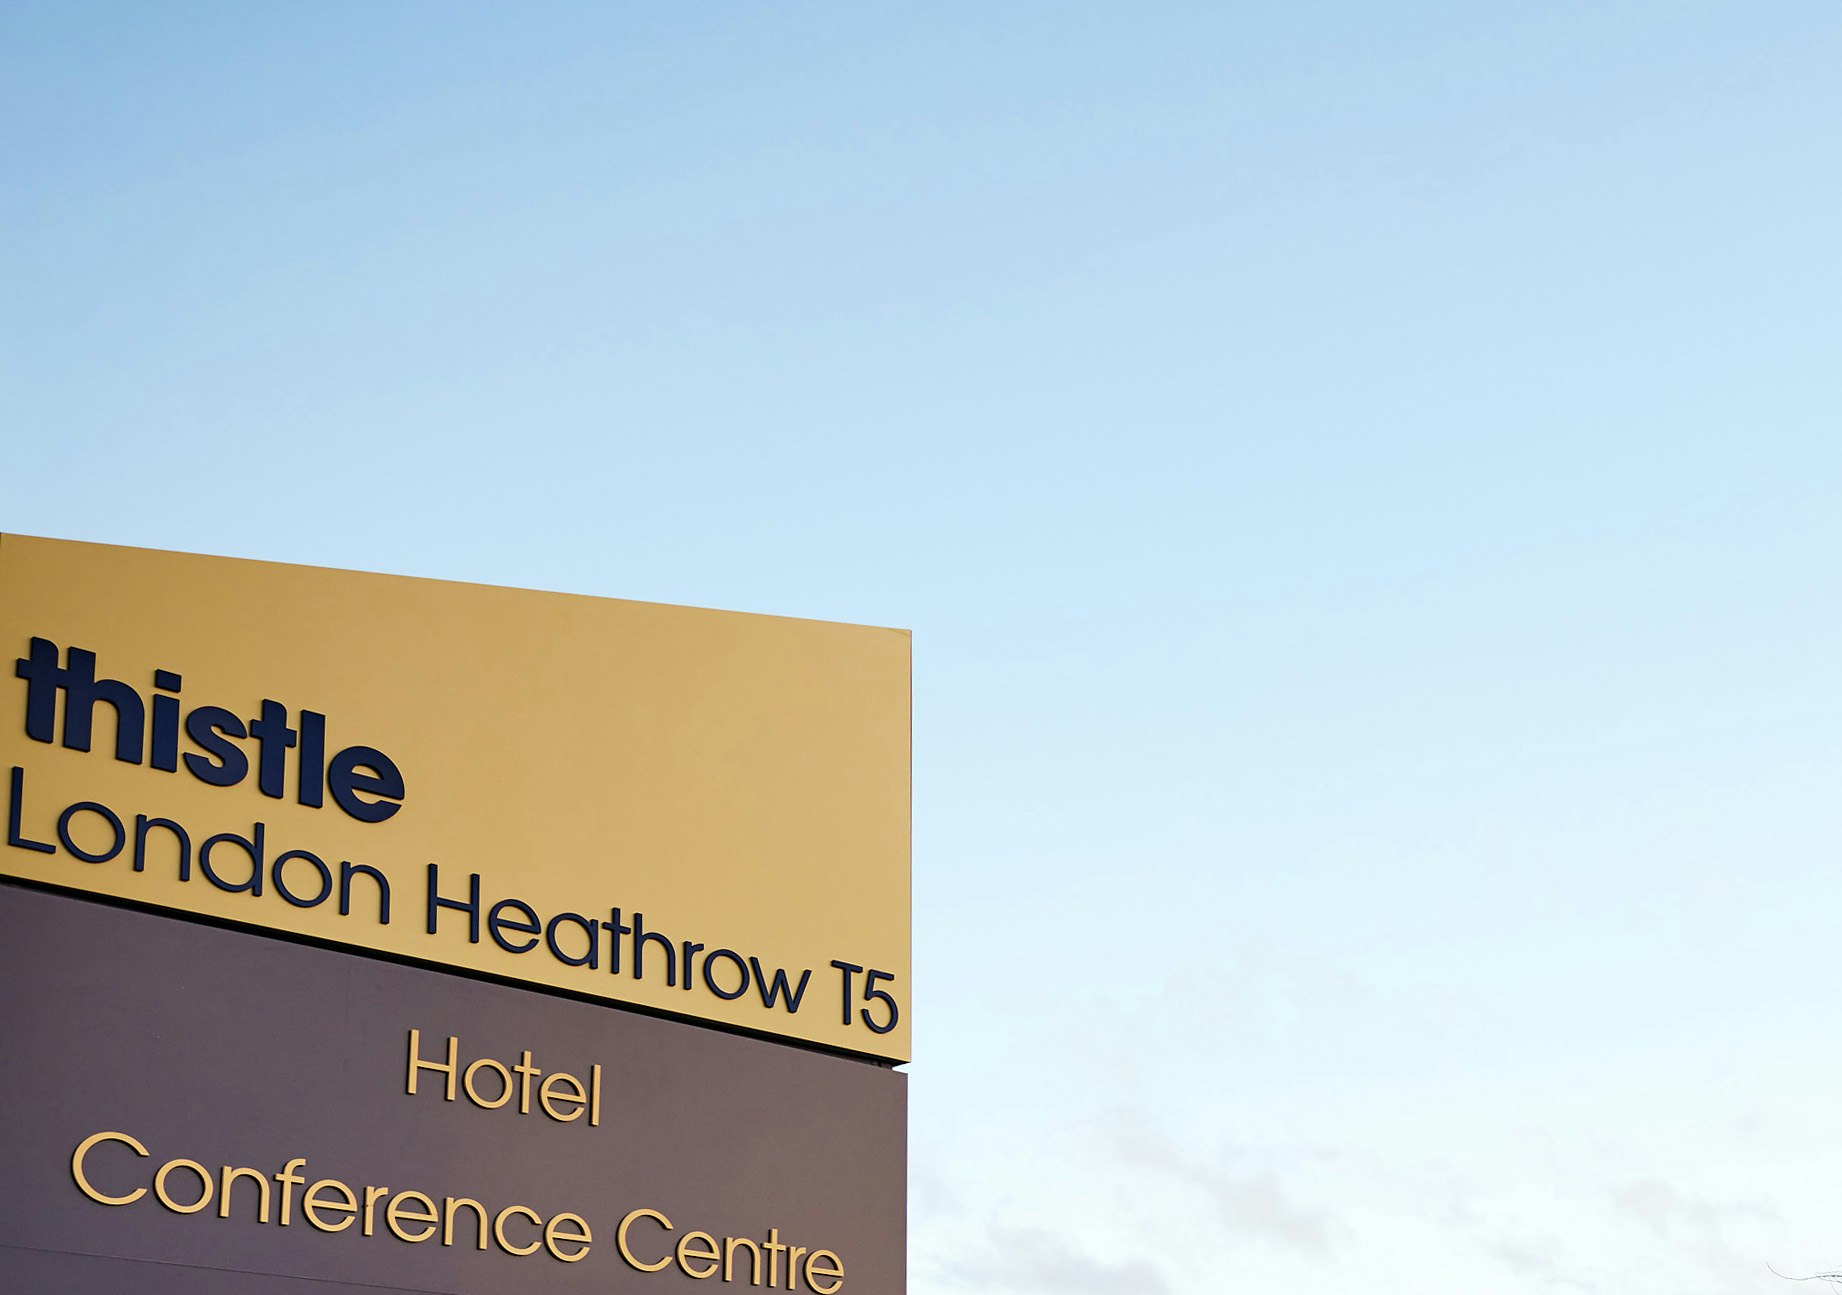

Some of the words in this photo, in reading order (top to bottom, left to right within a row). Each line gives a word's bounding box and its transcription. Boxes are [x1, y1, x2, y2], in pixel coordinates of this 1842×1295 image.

[16, 636, 406, 823] thistle
[8, 766, 391, 926] London
[427, 863, 812, 1014] Heathrow
[831, 960, 900, 1034] T5
[406, 1029, 601, 1127] Hotel
[70, 1131, 594, 1263] Conference
[617, 1208, 845, 1295] Centre
